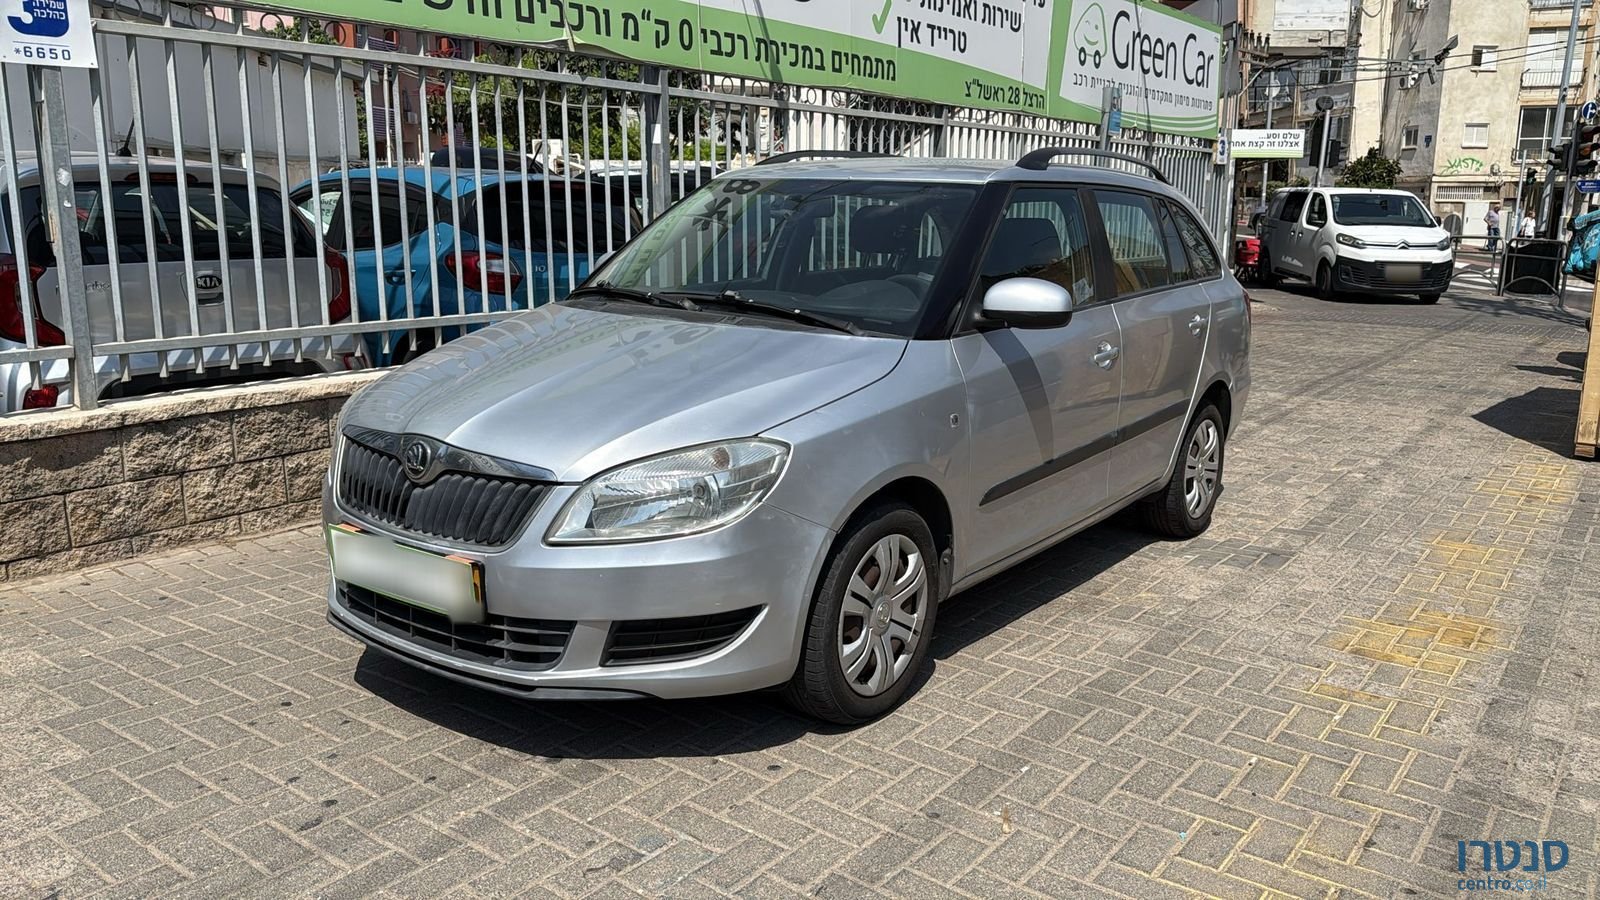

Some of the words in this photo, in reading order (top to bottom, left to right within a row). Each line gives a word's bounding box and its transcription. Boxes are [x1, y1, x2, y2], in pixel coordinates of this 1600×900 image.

[33, 8, 66, 20] כהלכה
[981, 2, 1022, 32] שירות
[679, 18, 693, 51] 0
[897, 16, 921, 48] אין
[926, 23, 967, 53] טרייד
[700, 28, 749, 60] רכבי
[755, 37, 826, 71] במכירת
[1112, 10, 1177, 81] Green
[1183, 33, 1214, 89] Car
[831, 50, 896, 81] מתמחים
[1073, 73, 1088, 88] רכב
[1008, 86, 1020, 105] 28
[1022, 87, 1045, 109] הרצל
[1248, 140, 1265, 149] קצת
[1266, 140, 1276, 148] זה
[1277, 140, 1300, 148] אצלנו
[1282, 131, 1301, 140] שלם
[197, 277, 219, 288] KIA
